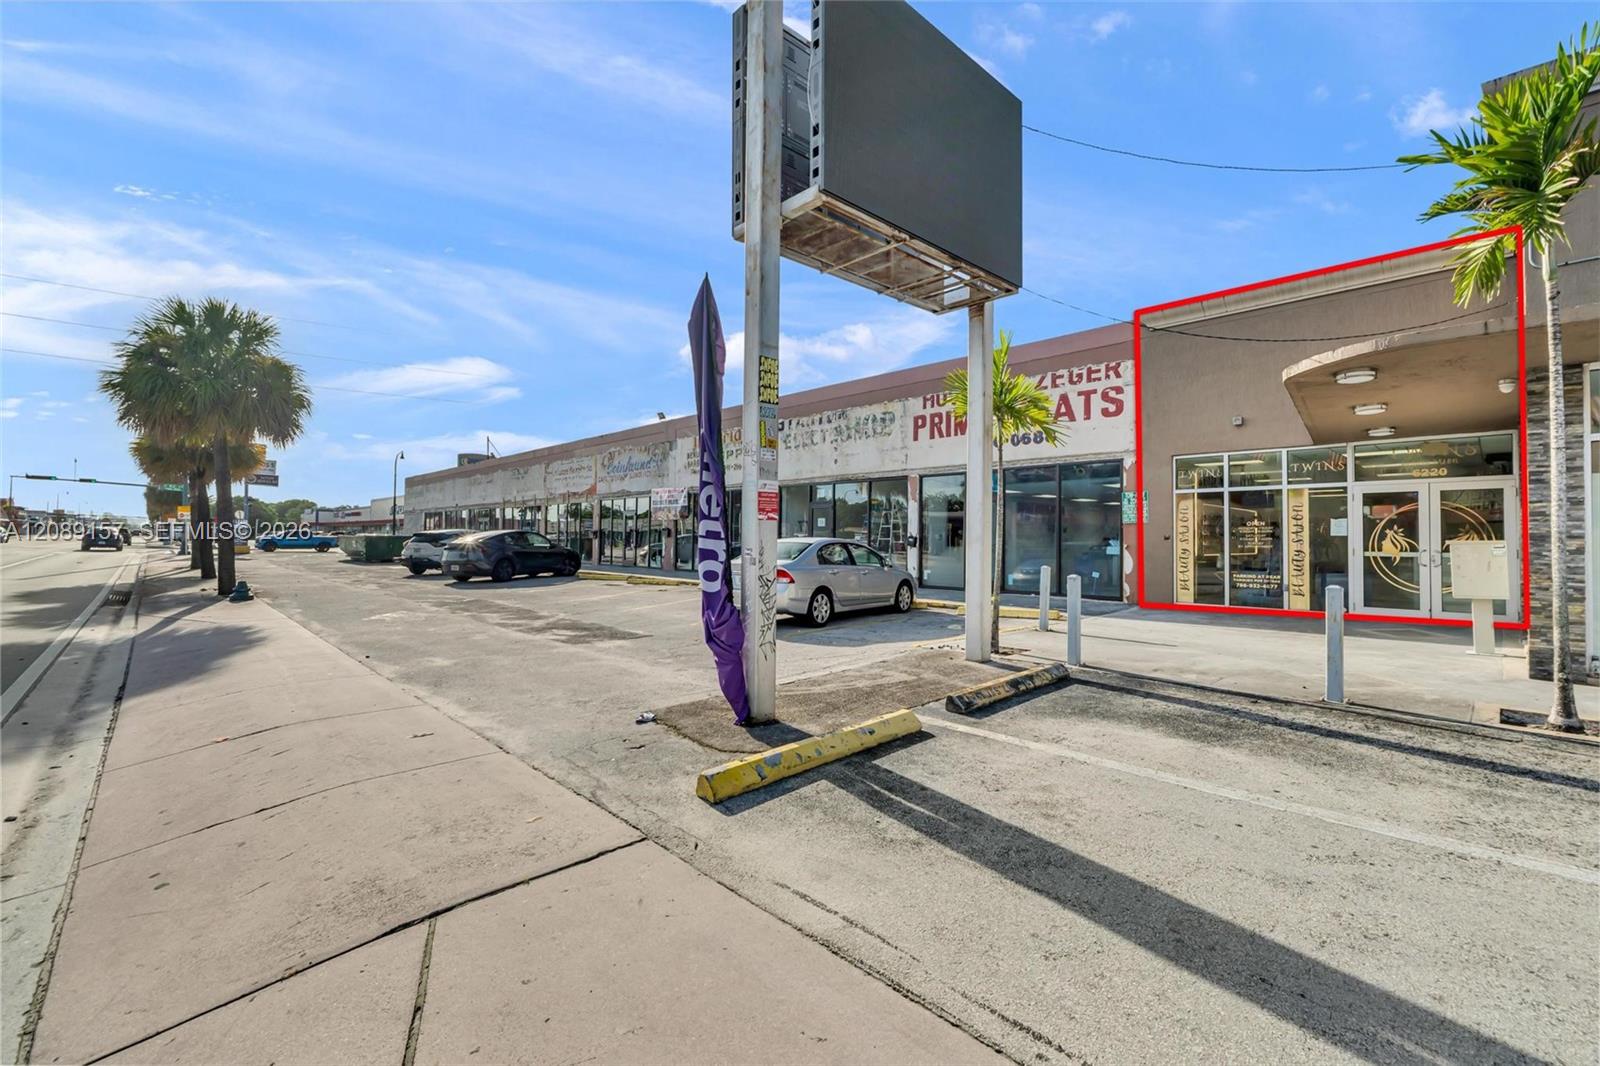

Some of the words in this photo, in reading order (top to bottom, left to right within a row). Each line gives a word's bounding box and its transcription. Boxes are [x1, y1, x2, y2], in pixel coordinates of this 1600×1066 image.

[1034, 361, 1123, 390] ZEGER
[912, 411, 968, 442] PRIM
[1053, 385, 1125, 422] ATS
[1291, 459, 1345, 473] TWINS
